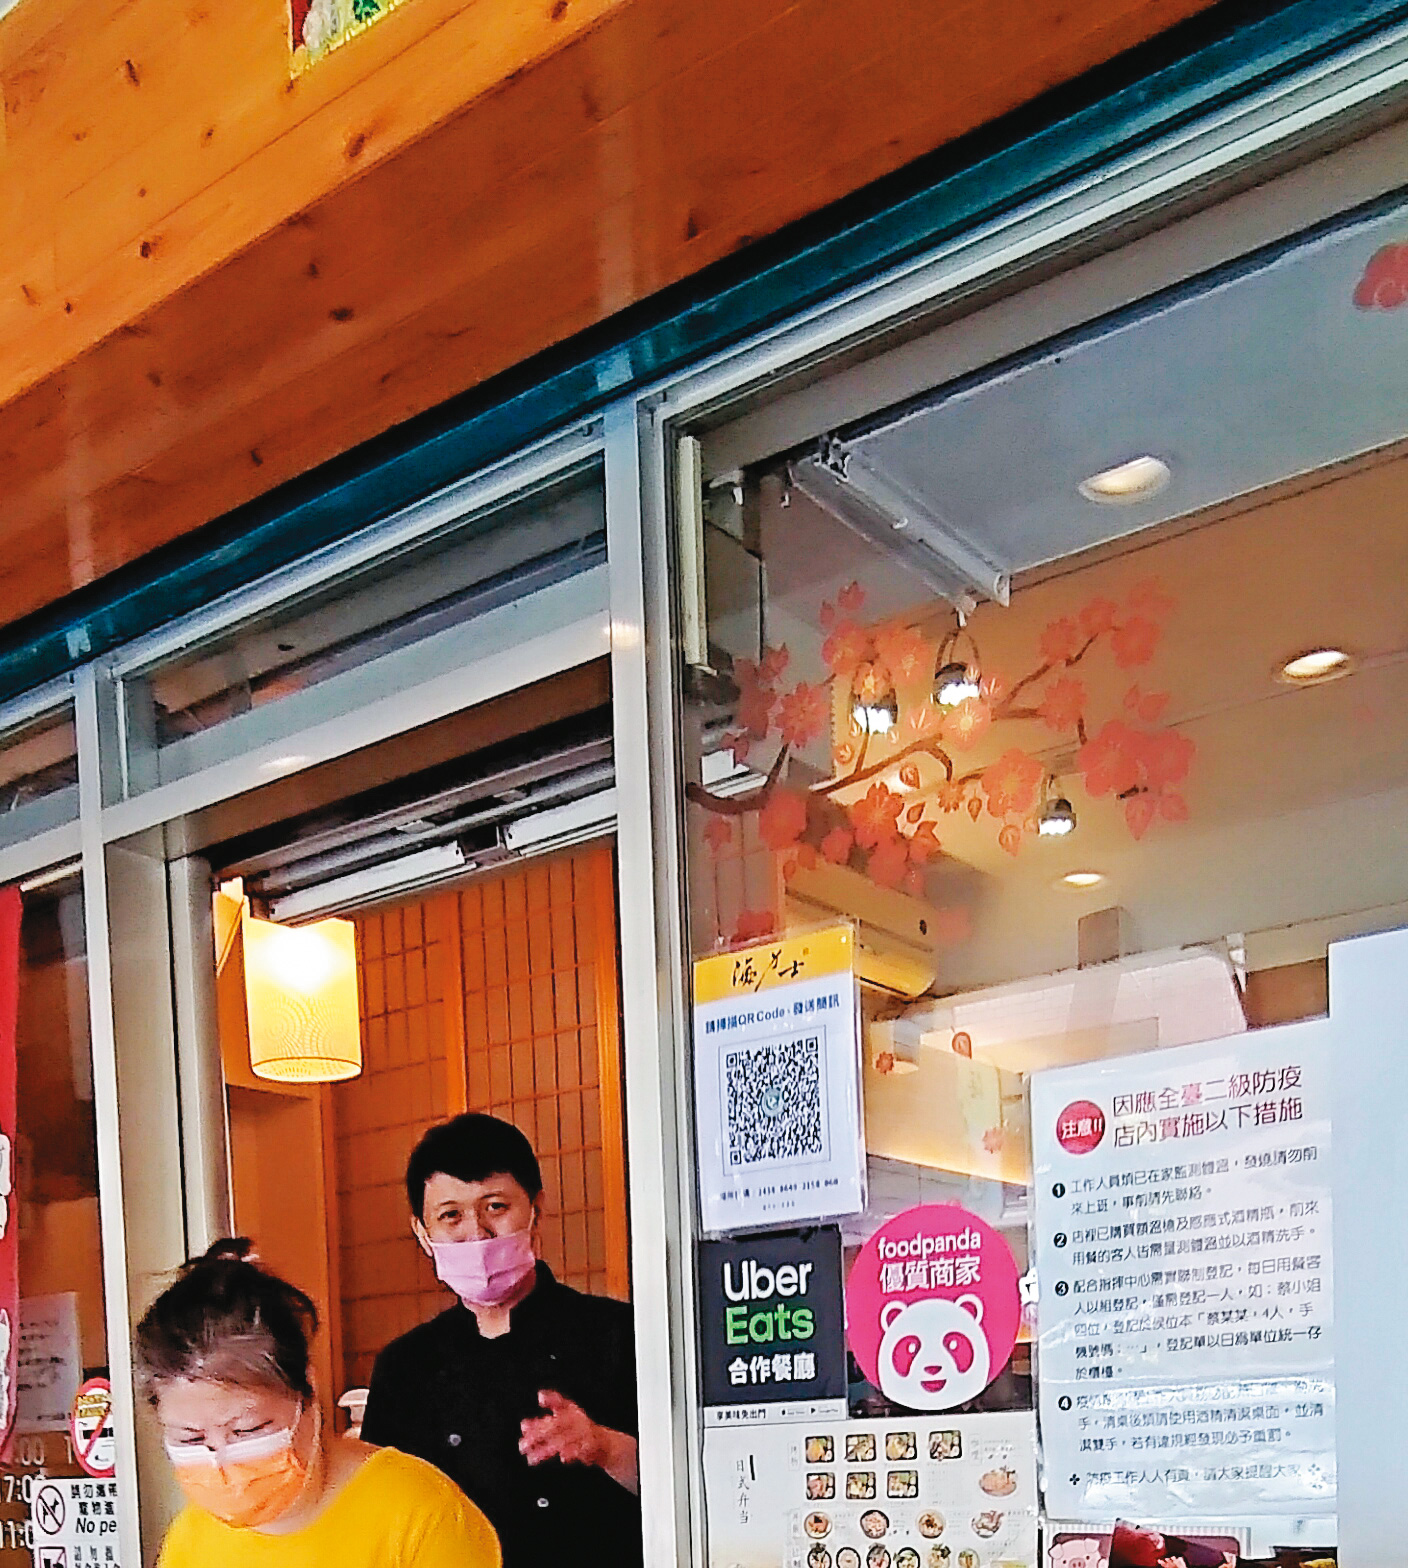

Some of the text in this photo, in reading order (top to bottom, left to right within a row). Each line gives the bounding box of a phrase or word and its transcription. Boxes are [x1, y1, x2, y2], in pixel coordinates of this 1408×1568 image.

[1113, 1066, 1303, 1117] 因應全臺二級防疫
[878, 1228, 981, 1261] foodpanda
[723, 1261, 812, 1301] Uber
[879, 1256, 981, 1293] 優質商家
[725, 1304, 814, 1344] Eats
[728, 1352, 816, 1386] 合作餐廳
[76, 1518, 95, 1533] No
